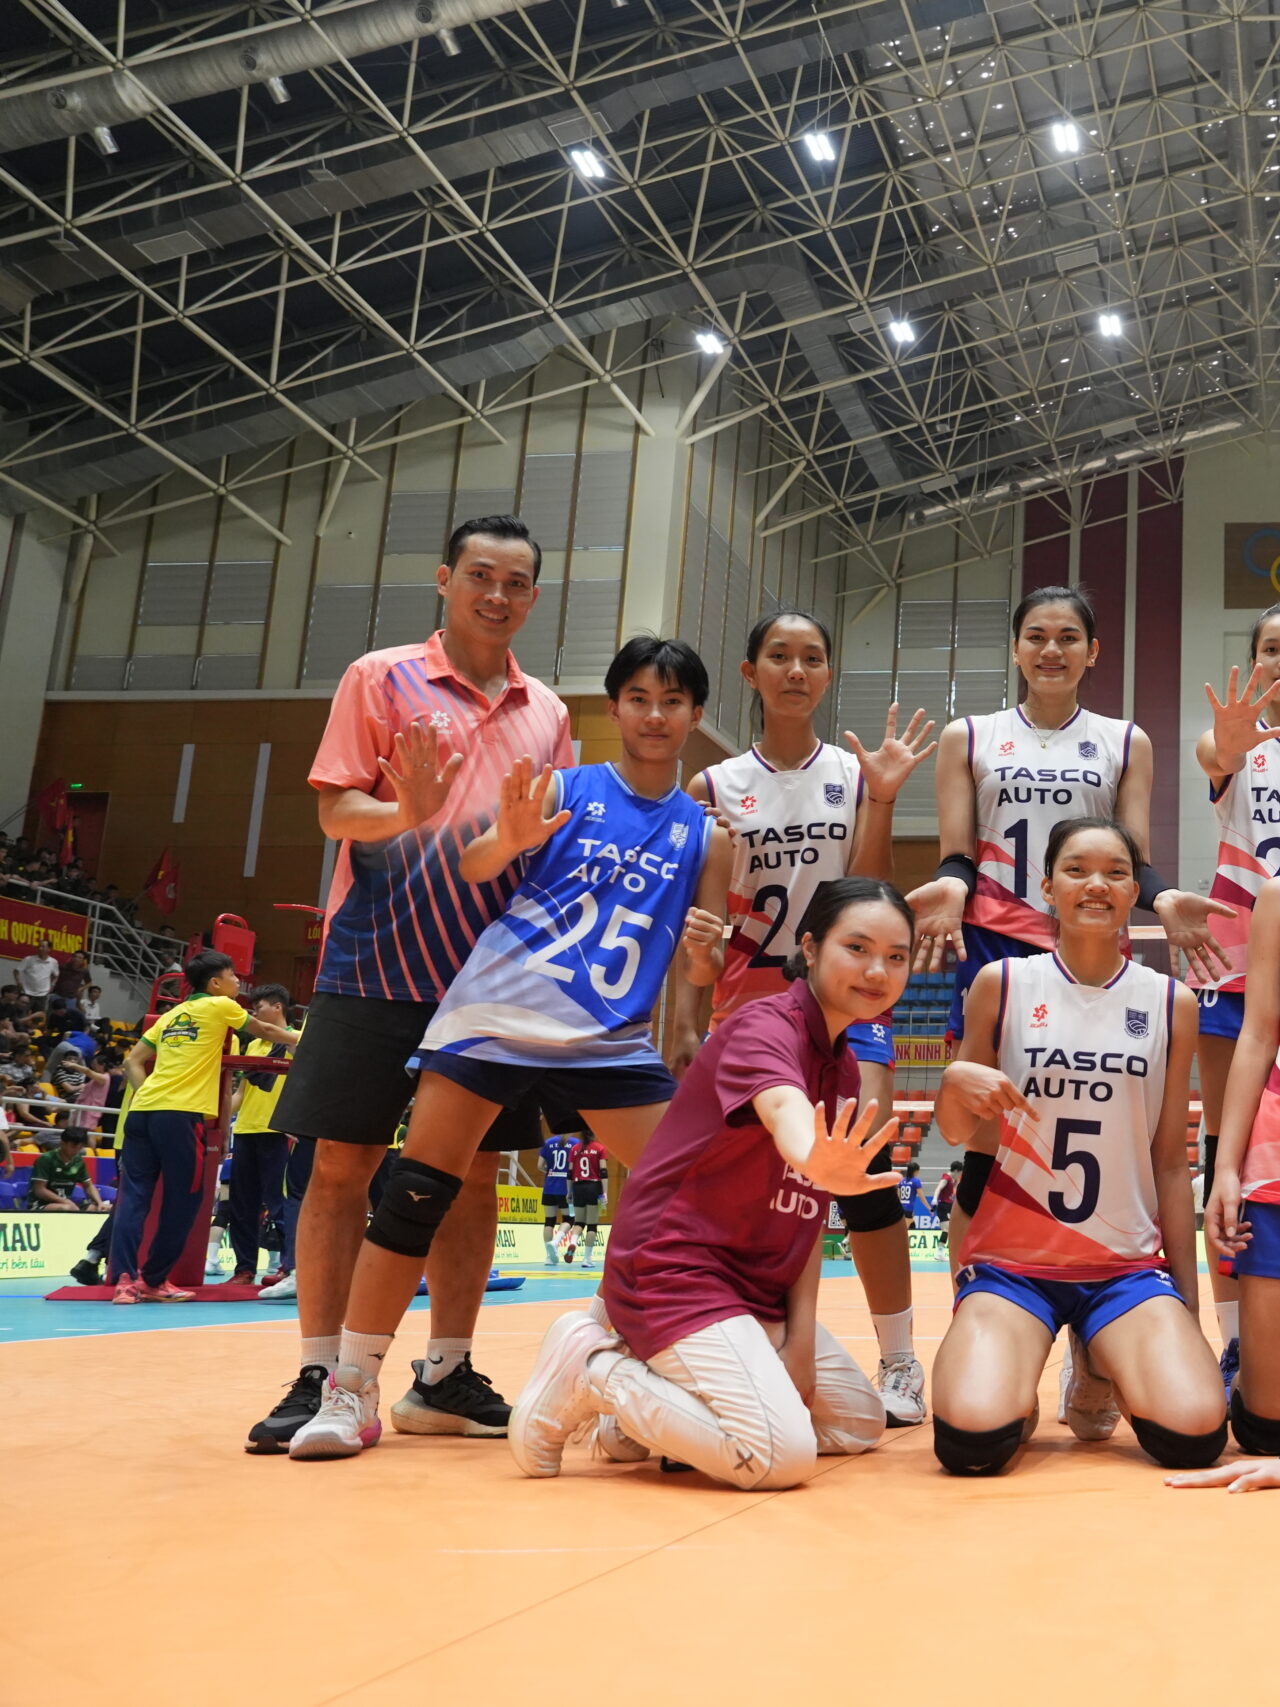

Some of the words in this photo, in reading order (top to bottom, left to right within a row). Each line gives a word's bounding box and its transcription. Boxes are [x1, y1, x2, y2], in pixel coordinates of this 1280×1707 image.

[994, 766, 1101, 788] TASCO
[998, 787, 1072, 807] AUTO
[741, 822, 847, 848] TASCO
[749, 847, 819, 874] AUTO
[567, 863, 646, 893] AUTO
[523, 892, 653, 1000] 25
[914, 1045, 941, 1059] NINH
[1024, 1047, 1148, 1078] TASCO
[1023, 1077, 1113, 1102] AUTO
[552, 1149, 567, 1170] 10
[580, 1156, 590, 1177] 9
[1048, 1117, 1102, 1224] 5
